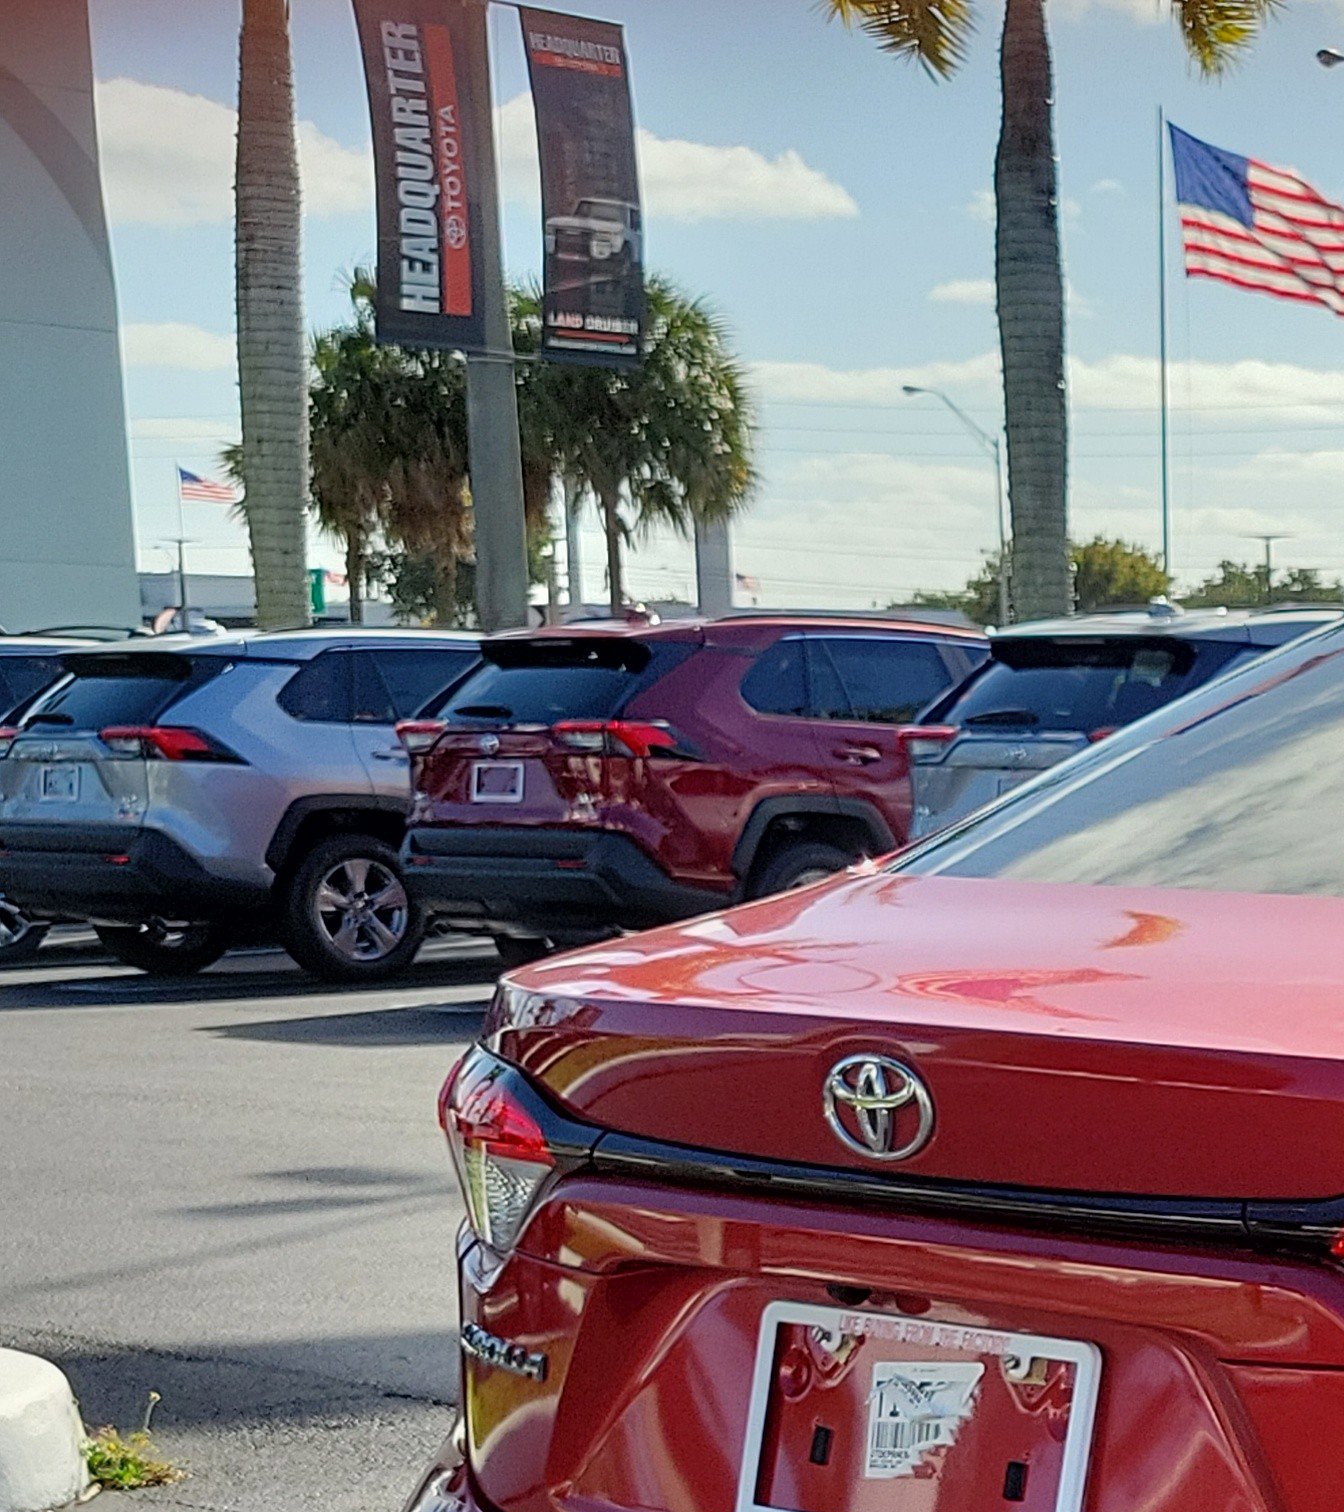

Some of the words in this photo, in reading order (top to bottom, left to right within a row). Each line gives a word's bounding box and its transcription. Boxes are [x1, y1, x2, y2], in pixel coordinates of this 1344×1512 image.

[529, 32, 621, 65] HEADQUARTER
[381, 20, 441, 315] HEADQUARTER
[437, 104, 465, 212] TOYOTA
